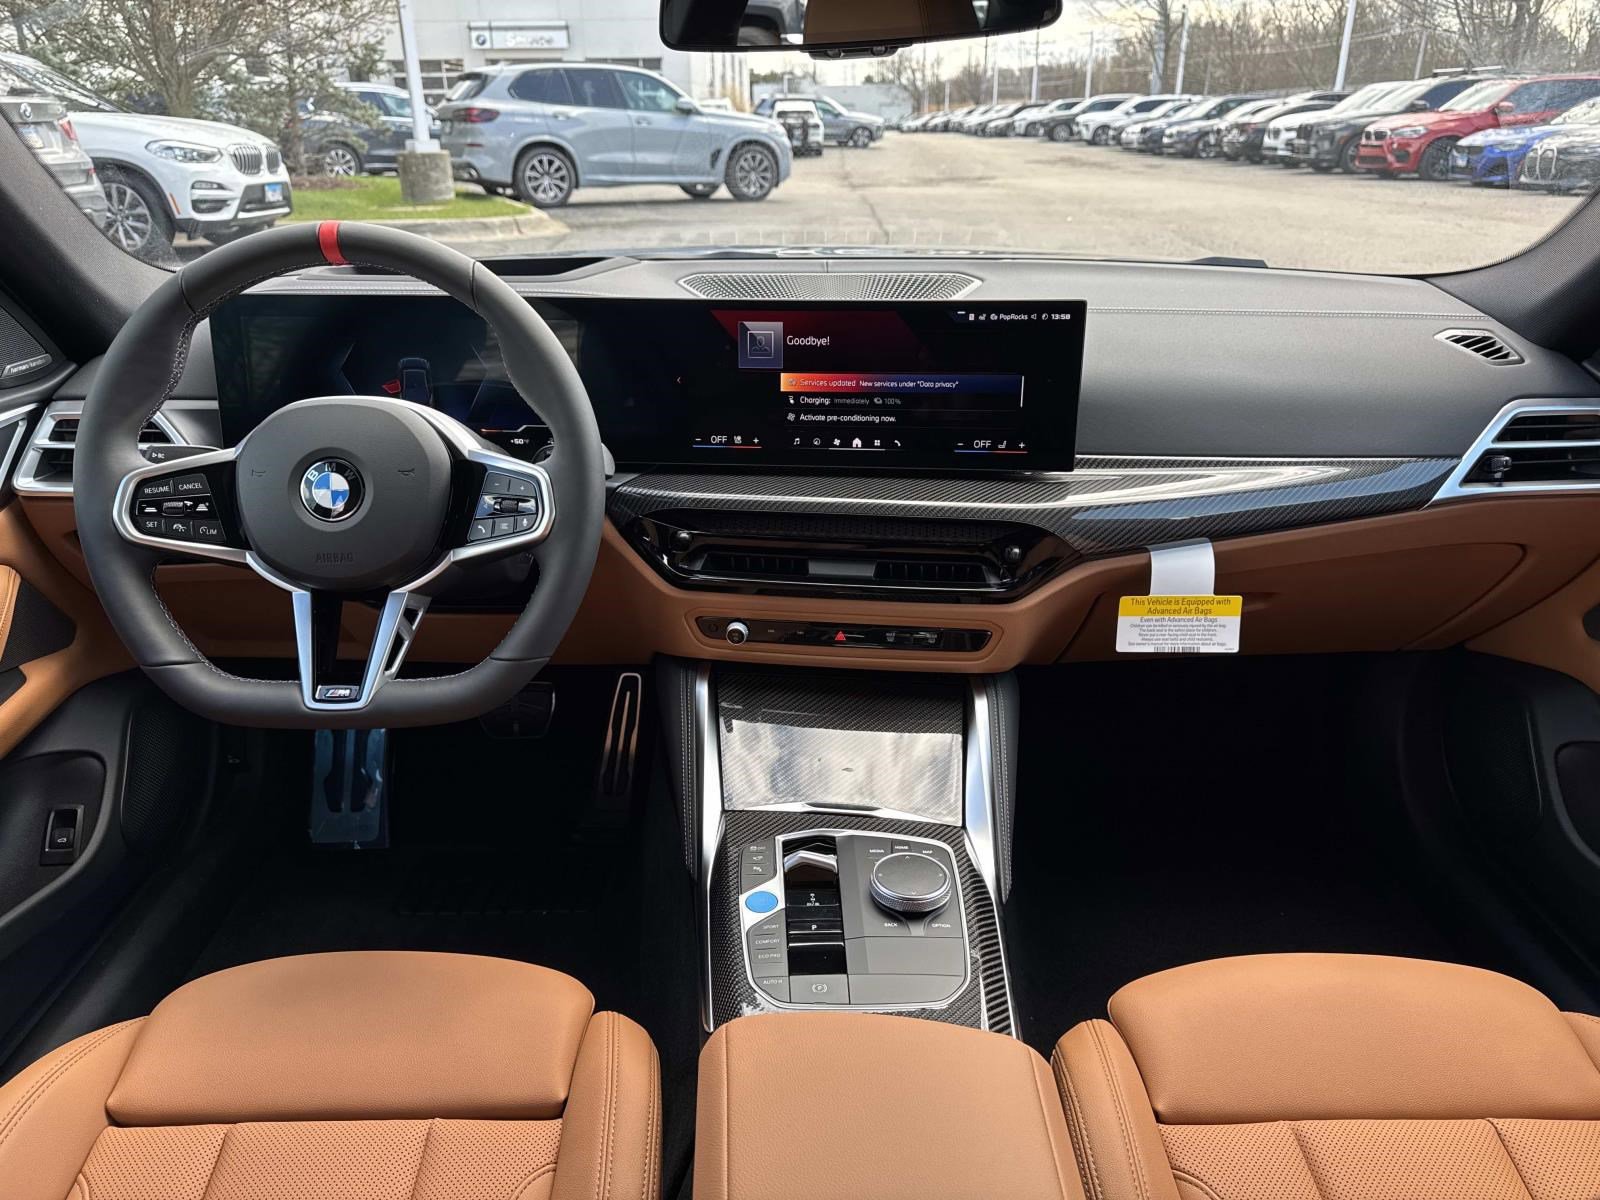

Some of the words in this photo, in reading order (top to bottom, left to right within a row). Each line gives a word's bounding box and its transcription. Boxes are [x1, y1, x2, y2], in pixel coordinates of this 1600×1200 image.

[999, 313, 1028, 321] PopRocks
[786, 335, 830, 347] Goodbye!
[800, 378, 827, 387] Services
[829, 379, 856, 389] updated
[800, 396, 830, 406] Charging:
[800, 413, 825, 422] Activate
[827, 414, 879, 424] pre-conditioning
[710, 435, 727, 444] OFF
[973, 439, 992, 449] OFF
[307, 462, 356, 481] BMW
[144, 485, 170, 494] RESUME
[178, 482, 203, 491] CANCEL
[1131, 598, 1146, 606] This
[1147, 597, 1172, 606] Vehicle
[1181, 598, 1214, 607] Equipped
[1147, 607, 1181, 615] Advanced
[1183, 607, 1192, 615] Air
[1194, 607, 1213, 616] Bags
